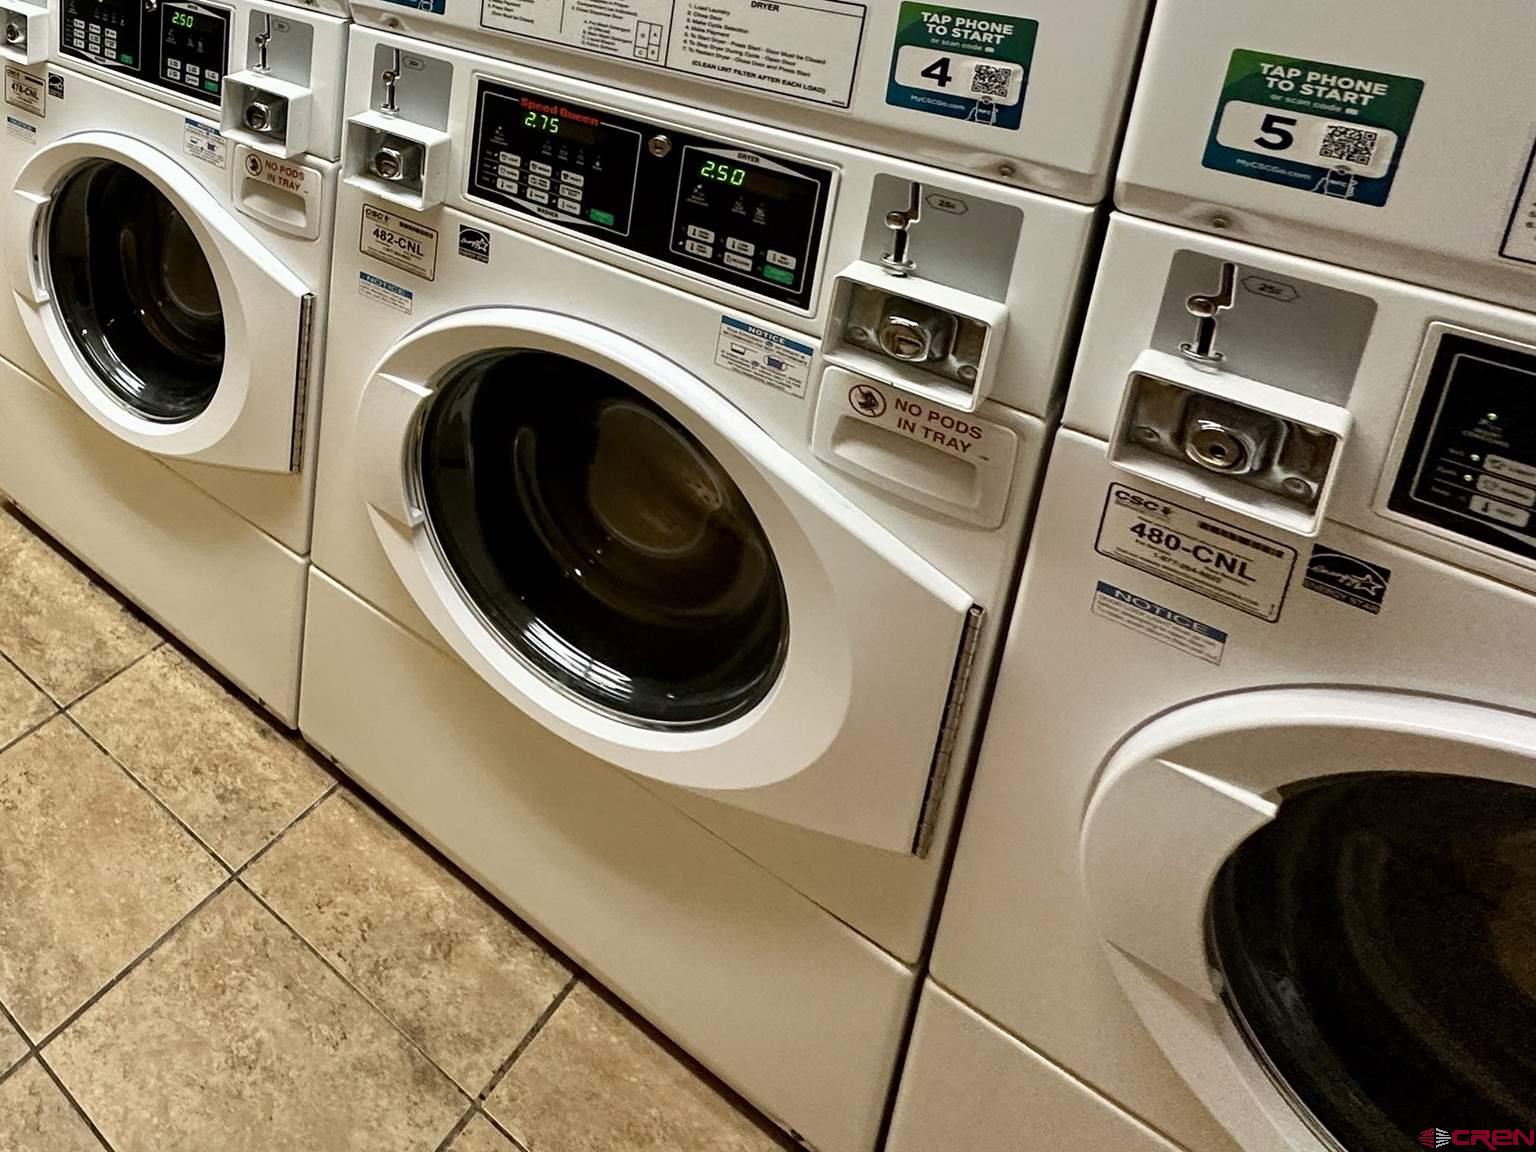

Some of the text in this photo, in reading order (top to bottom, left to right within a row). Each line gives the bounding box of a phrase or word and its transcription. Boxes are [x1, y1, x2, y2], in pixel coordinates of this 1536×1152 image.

[750, 0, 779, 12] DRYER
[921, 12, 1014, 35] TAP PHONE
[926, 24, 1005, 45] TO START
[961, 42, 983, 51] code
[733, 69, 756, 79] FILTER
[757, 74, 781, 84] AFTER
[782, 79, 802, 89] EACH
[921, 57, 952, 87] 4
[1260, 63, 1389, 96] TAP PHONE
[1265, 76, 1375, 106] TO START
[520, 97, 600, 127] Speed Queen
[1285, 96, 1311, 106] scan
[1314, 101, 1342, 113] code
[524, 111, 560, 134] 2.75
[1254, 113, 1298, 151] 5
[738, 152, 760, 164] DRYER
[1236, 157, 1312, 180] MyCSCGo.com
[265, 159, 305, 182] NO PODS
[700, 160, 746, 186] 2.50
[267, 173, 301, 192] IN TRAY
[365, 208, 384, 220] CSC
[372, 228, 425, 257] 482-CNL
[748, 326, 785, 344] NOTICE
[895, 398, 983, 440] NO PODS
[897, 417, 972, 453] IN TRAY
[1115, 490, 1160, 512] CSC
[1130, 523, 1257, 583] 480-CNL
[1115, 590, 1209, 634] NOTICE
